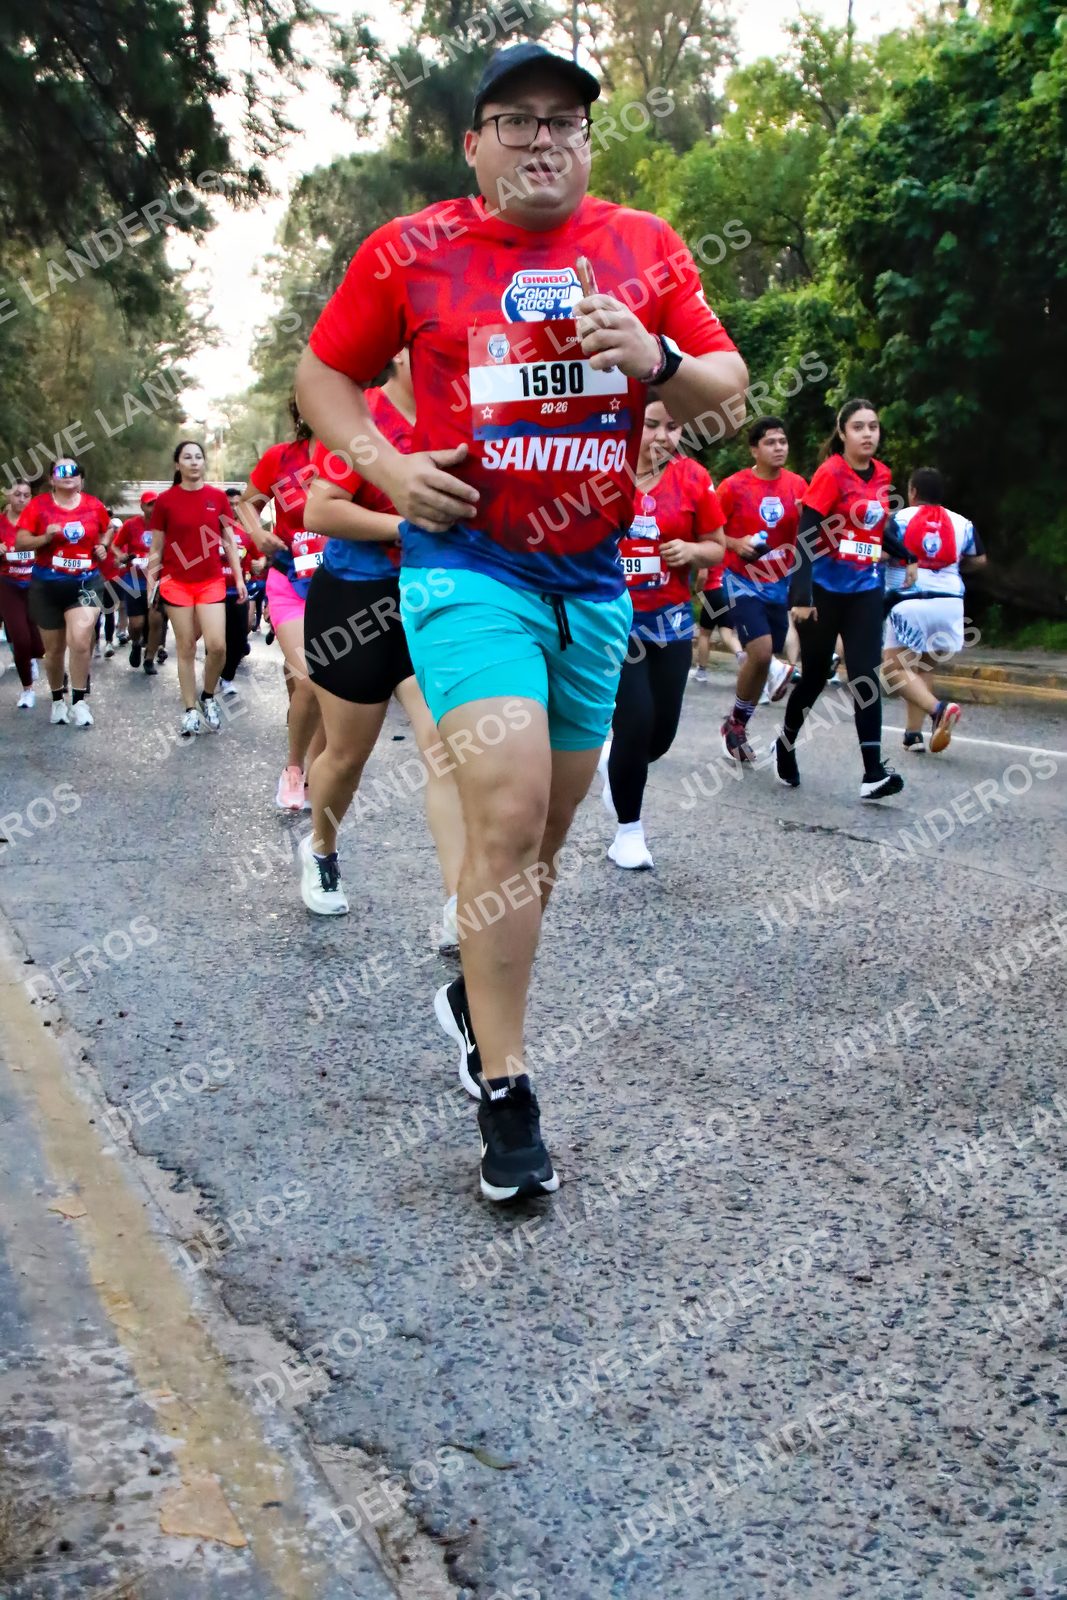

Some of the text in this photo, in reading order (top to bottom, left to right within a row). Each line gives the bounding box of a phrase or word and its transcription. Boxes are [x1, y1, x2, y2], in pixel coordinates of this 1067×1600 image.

[522, 275, 569, 284] BIMBO
[525, 287, 570, 300] Global
[516, 298, 554, 311] Race
[519, 362, 584, 397] 1590
[601, 413, 616, 424] 5K
[482, 436, 627, 473] SANTIAGO
